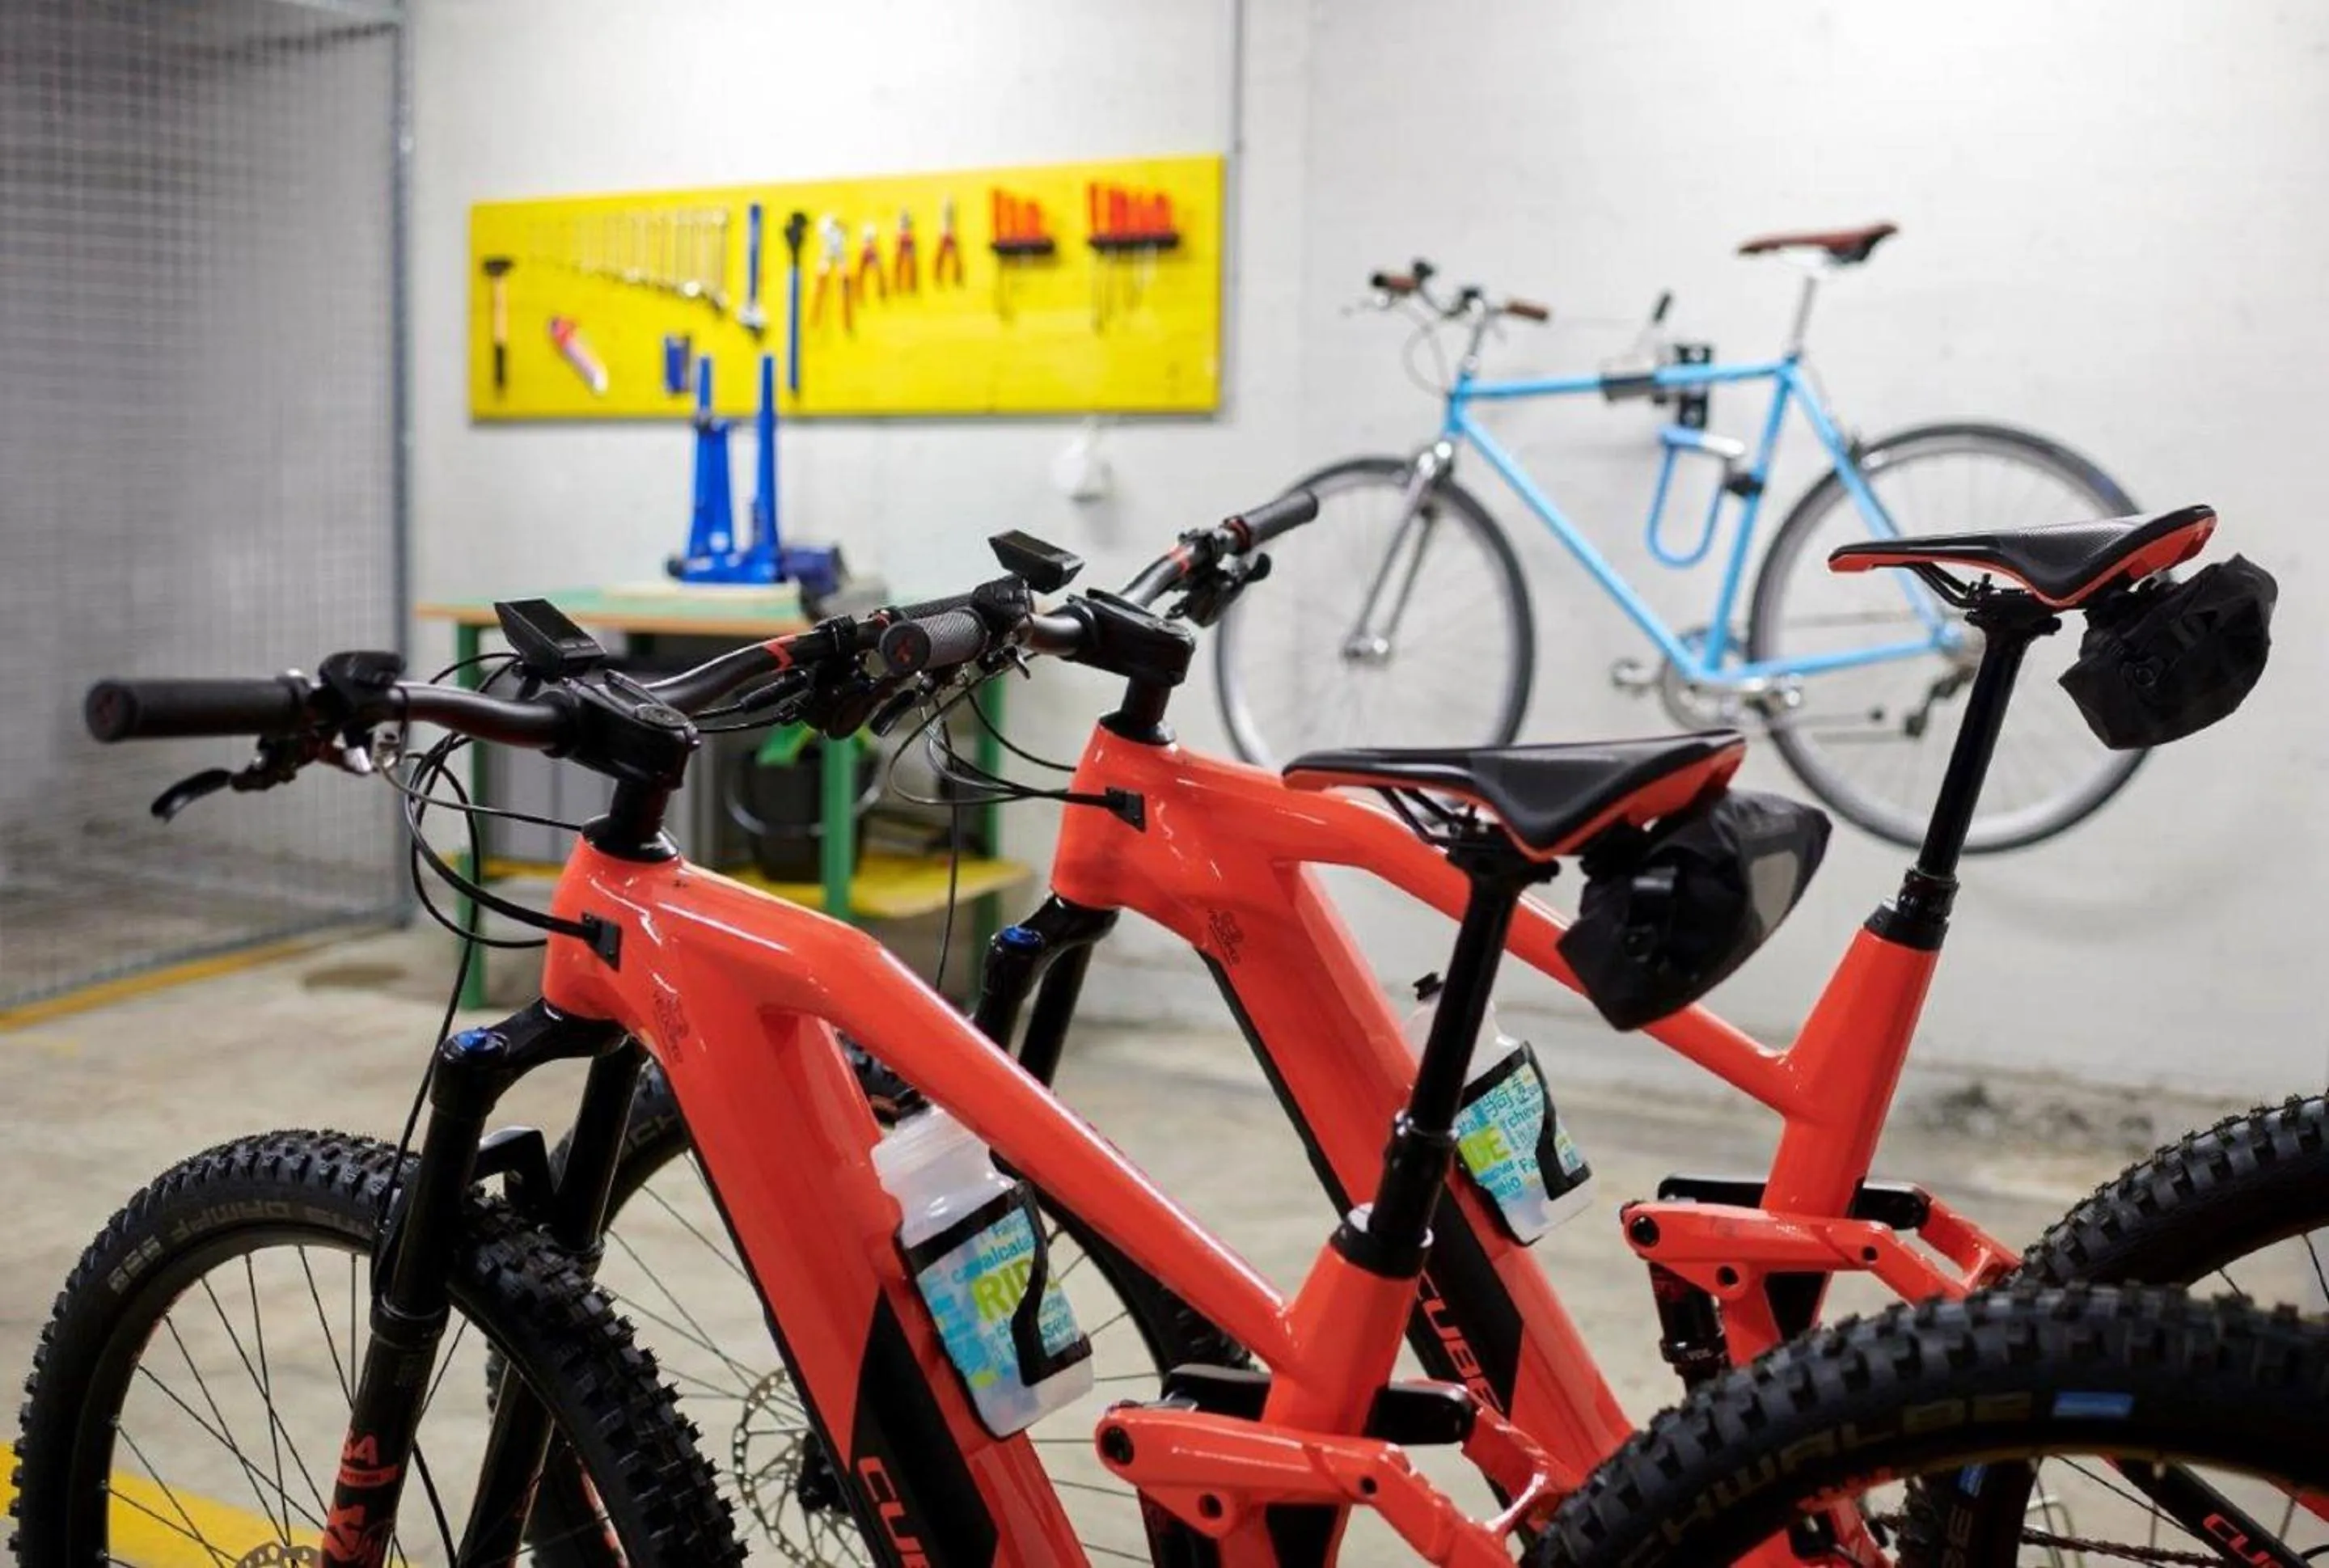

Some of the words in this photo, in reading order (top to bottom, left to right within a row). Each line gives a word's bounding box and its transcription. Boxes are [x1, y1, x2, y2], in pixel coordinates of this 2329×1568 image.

[171, 1200, 291, 1244] DAMPF
[972, 1253, 1058, 1321] RID
[857, 1456, 932, 1568] CU
[1620, 1390, 2033, 1568] CHWALBE
[2202, 1512, 2279, 1568] CU
